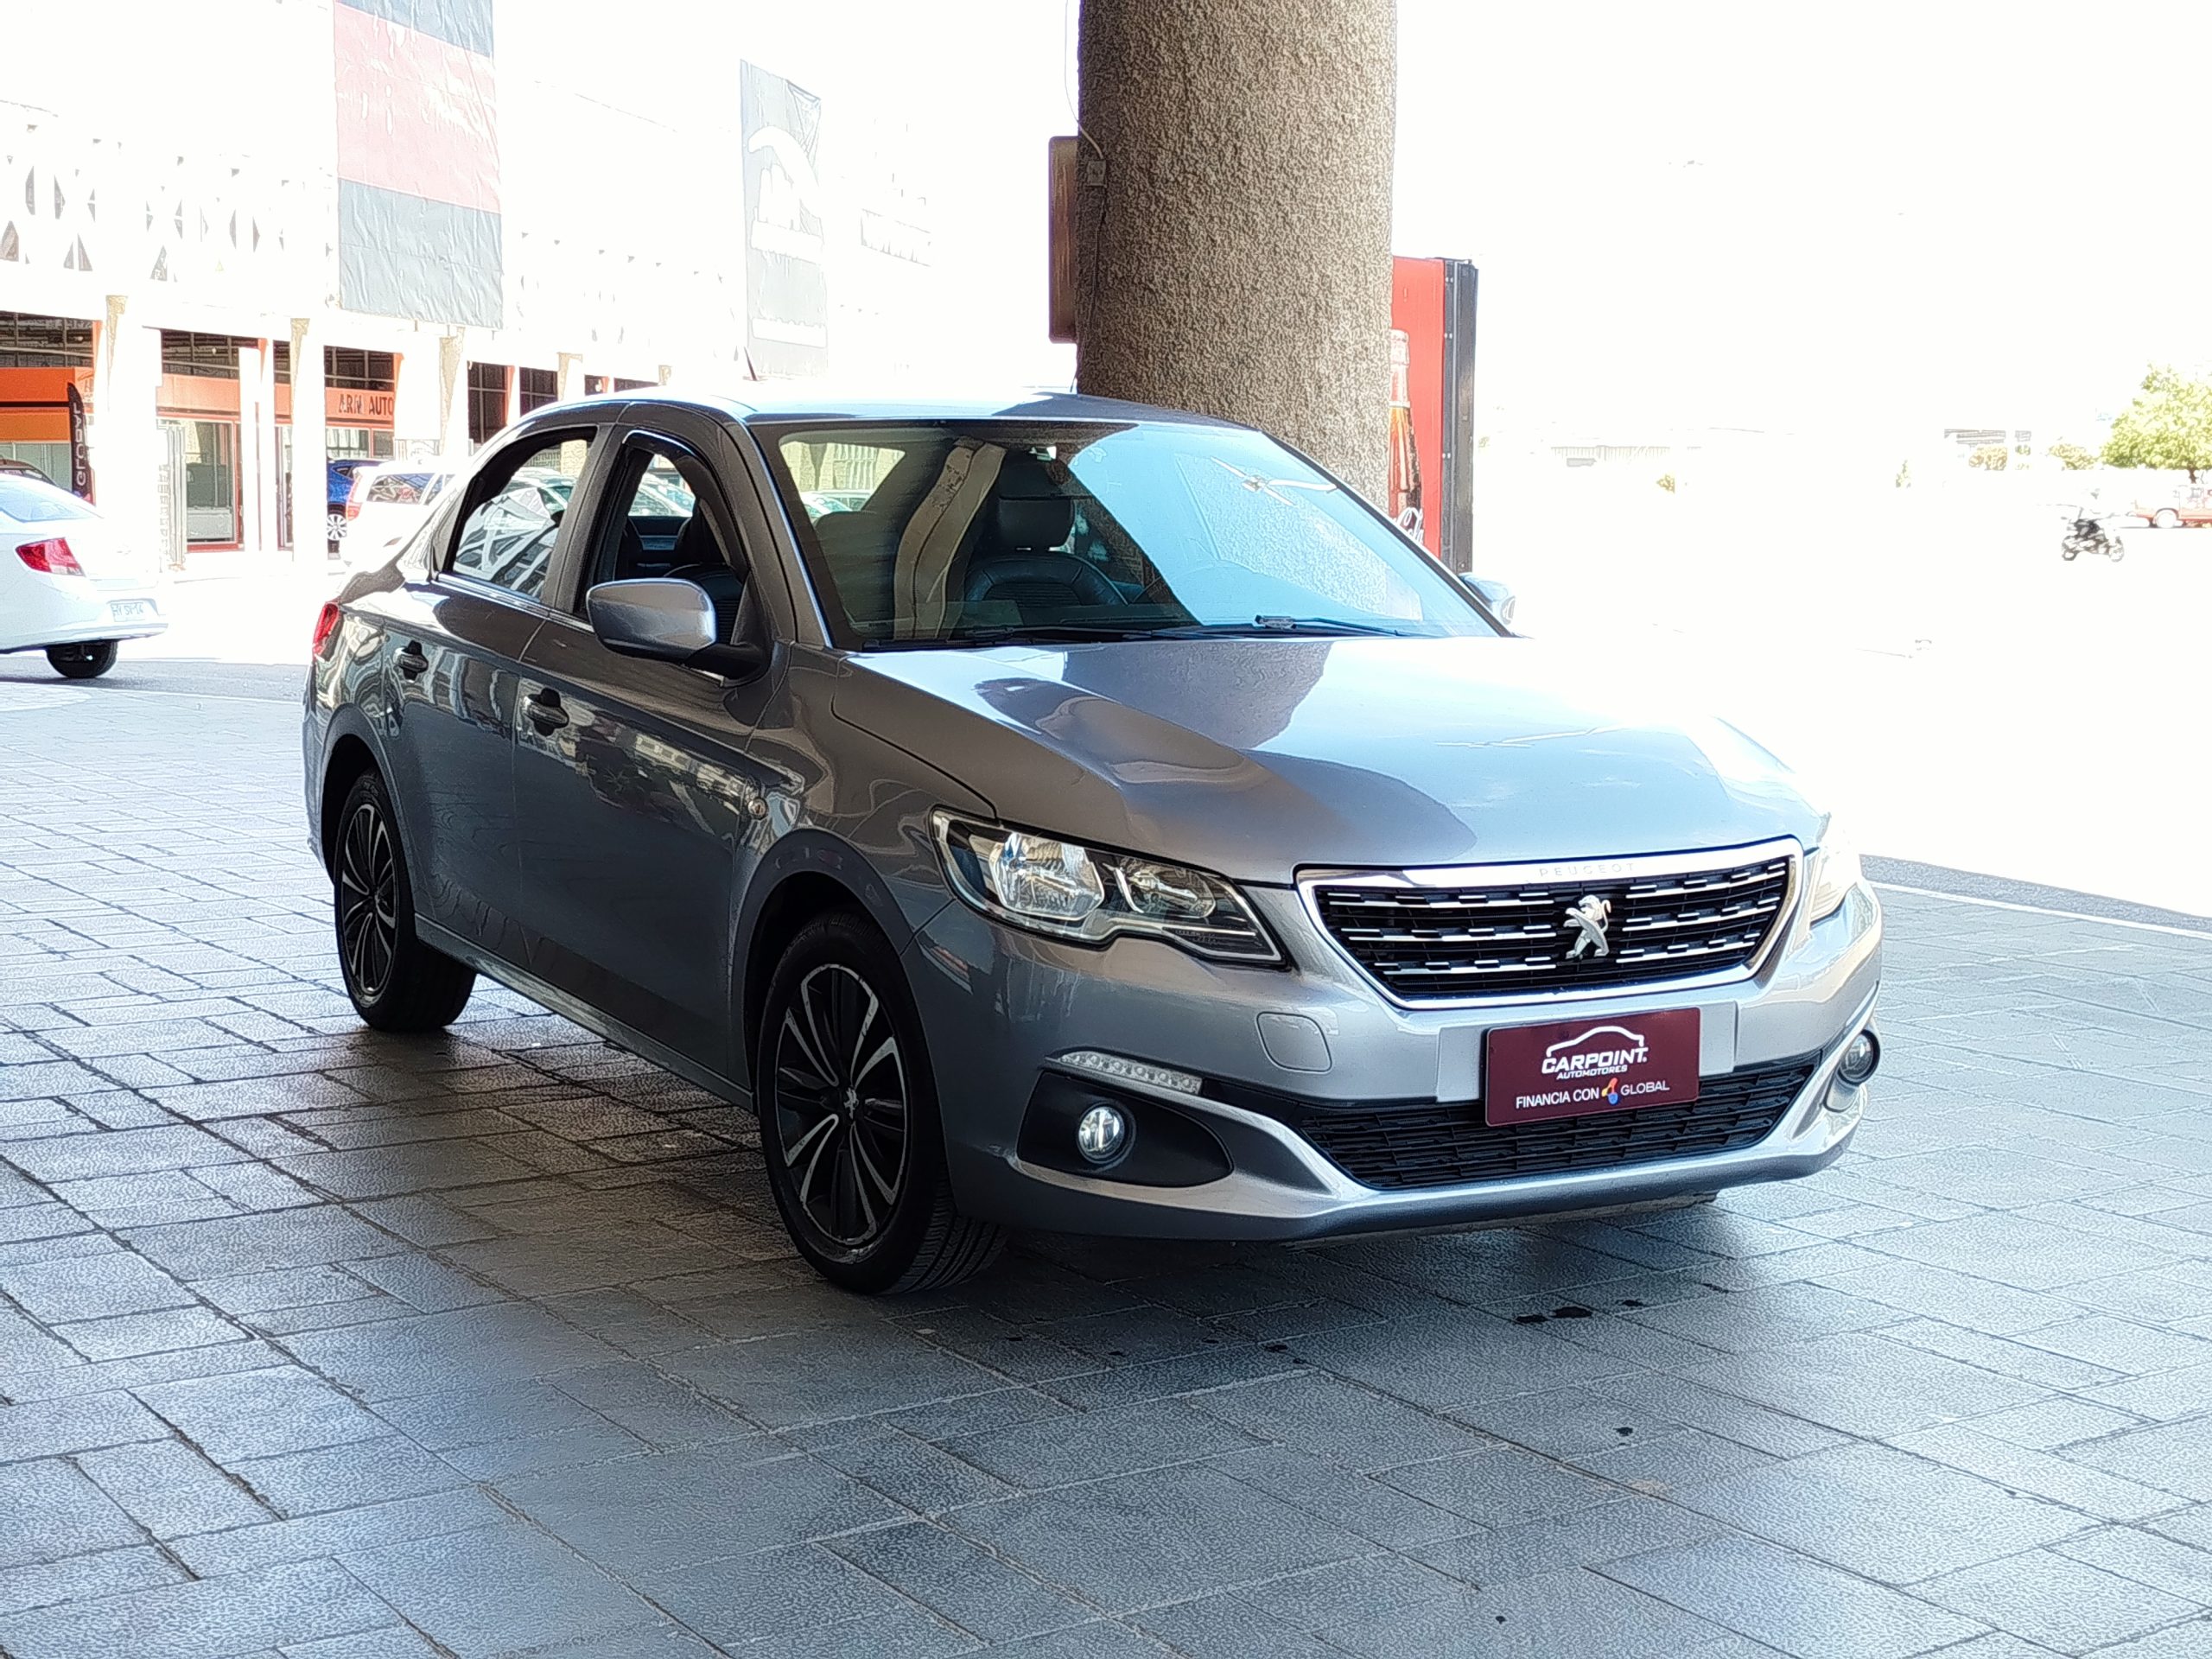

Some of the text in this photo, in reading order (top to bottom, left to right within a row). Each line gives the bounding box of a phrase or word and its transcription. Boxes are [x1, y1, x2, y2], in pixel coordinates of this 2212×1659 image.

[1539, 862, 1635, 877] PEUGEOT
[1556, 1065, 1628, 1080] AUTOMOTORES
[1516, 1080, 1670, 1109] FINANCIA CON GLOBAL
